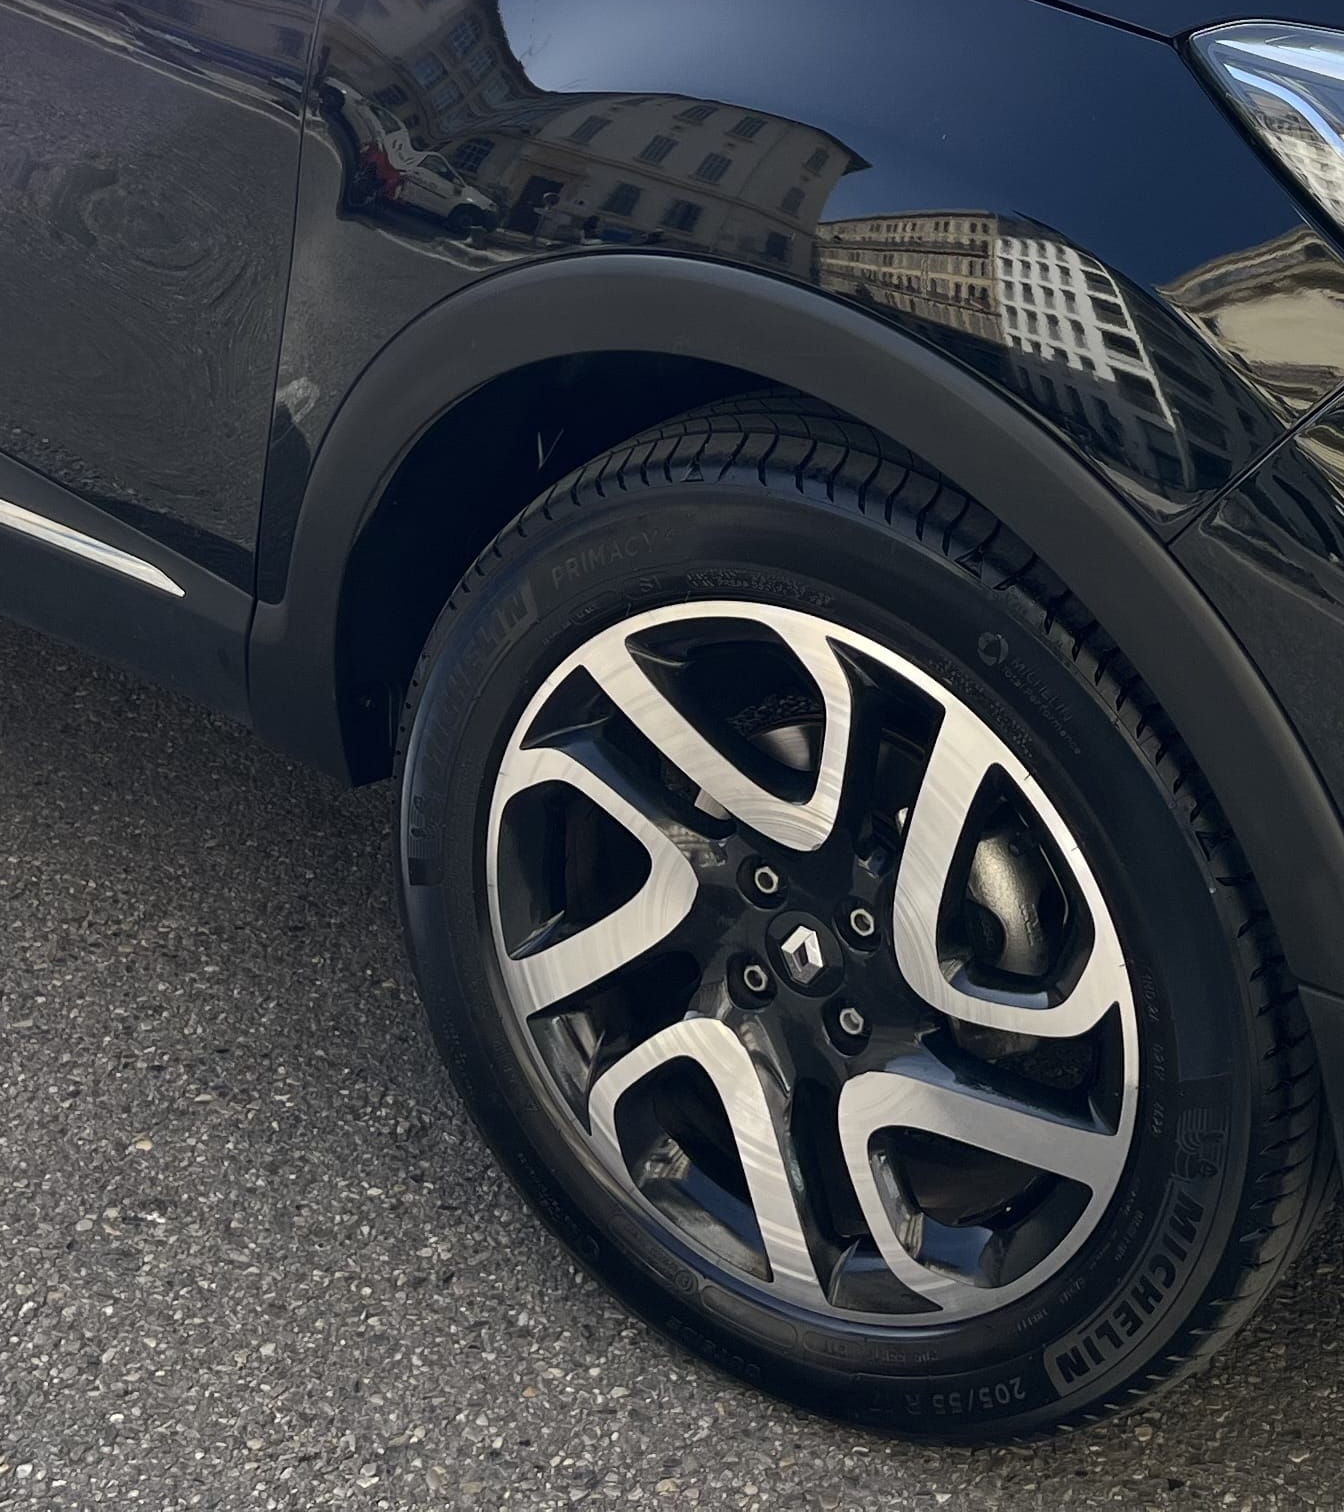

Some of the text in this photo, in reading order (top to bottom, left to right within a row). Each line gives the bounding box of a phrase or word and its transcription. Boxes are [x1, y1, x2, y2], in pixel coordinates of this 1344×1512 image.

[551, 527, 659, 590] PRIMACY
[1056, 1195, 1205, 1385] MICHELIN
[932, 1375, 1027, 1415] 205/55
